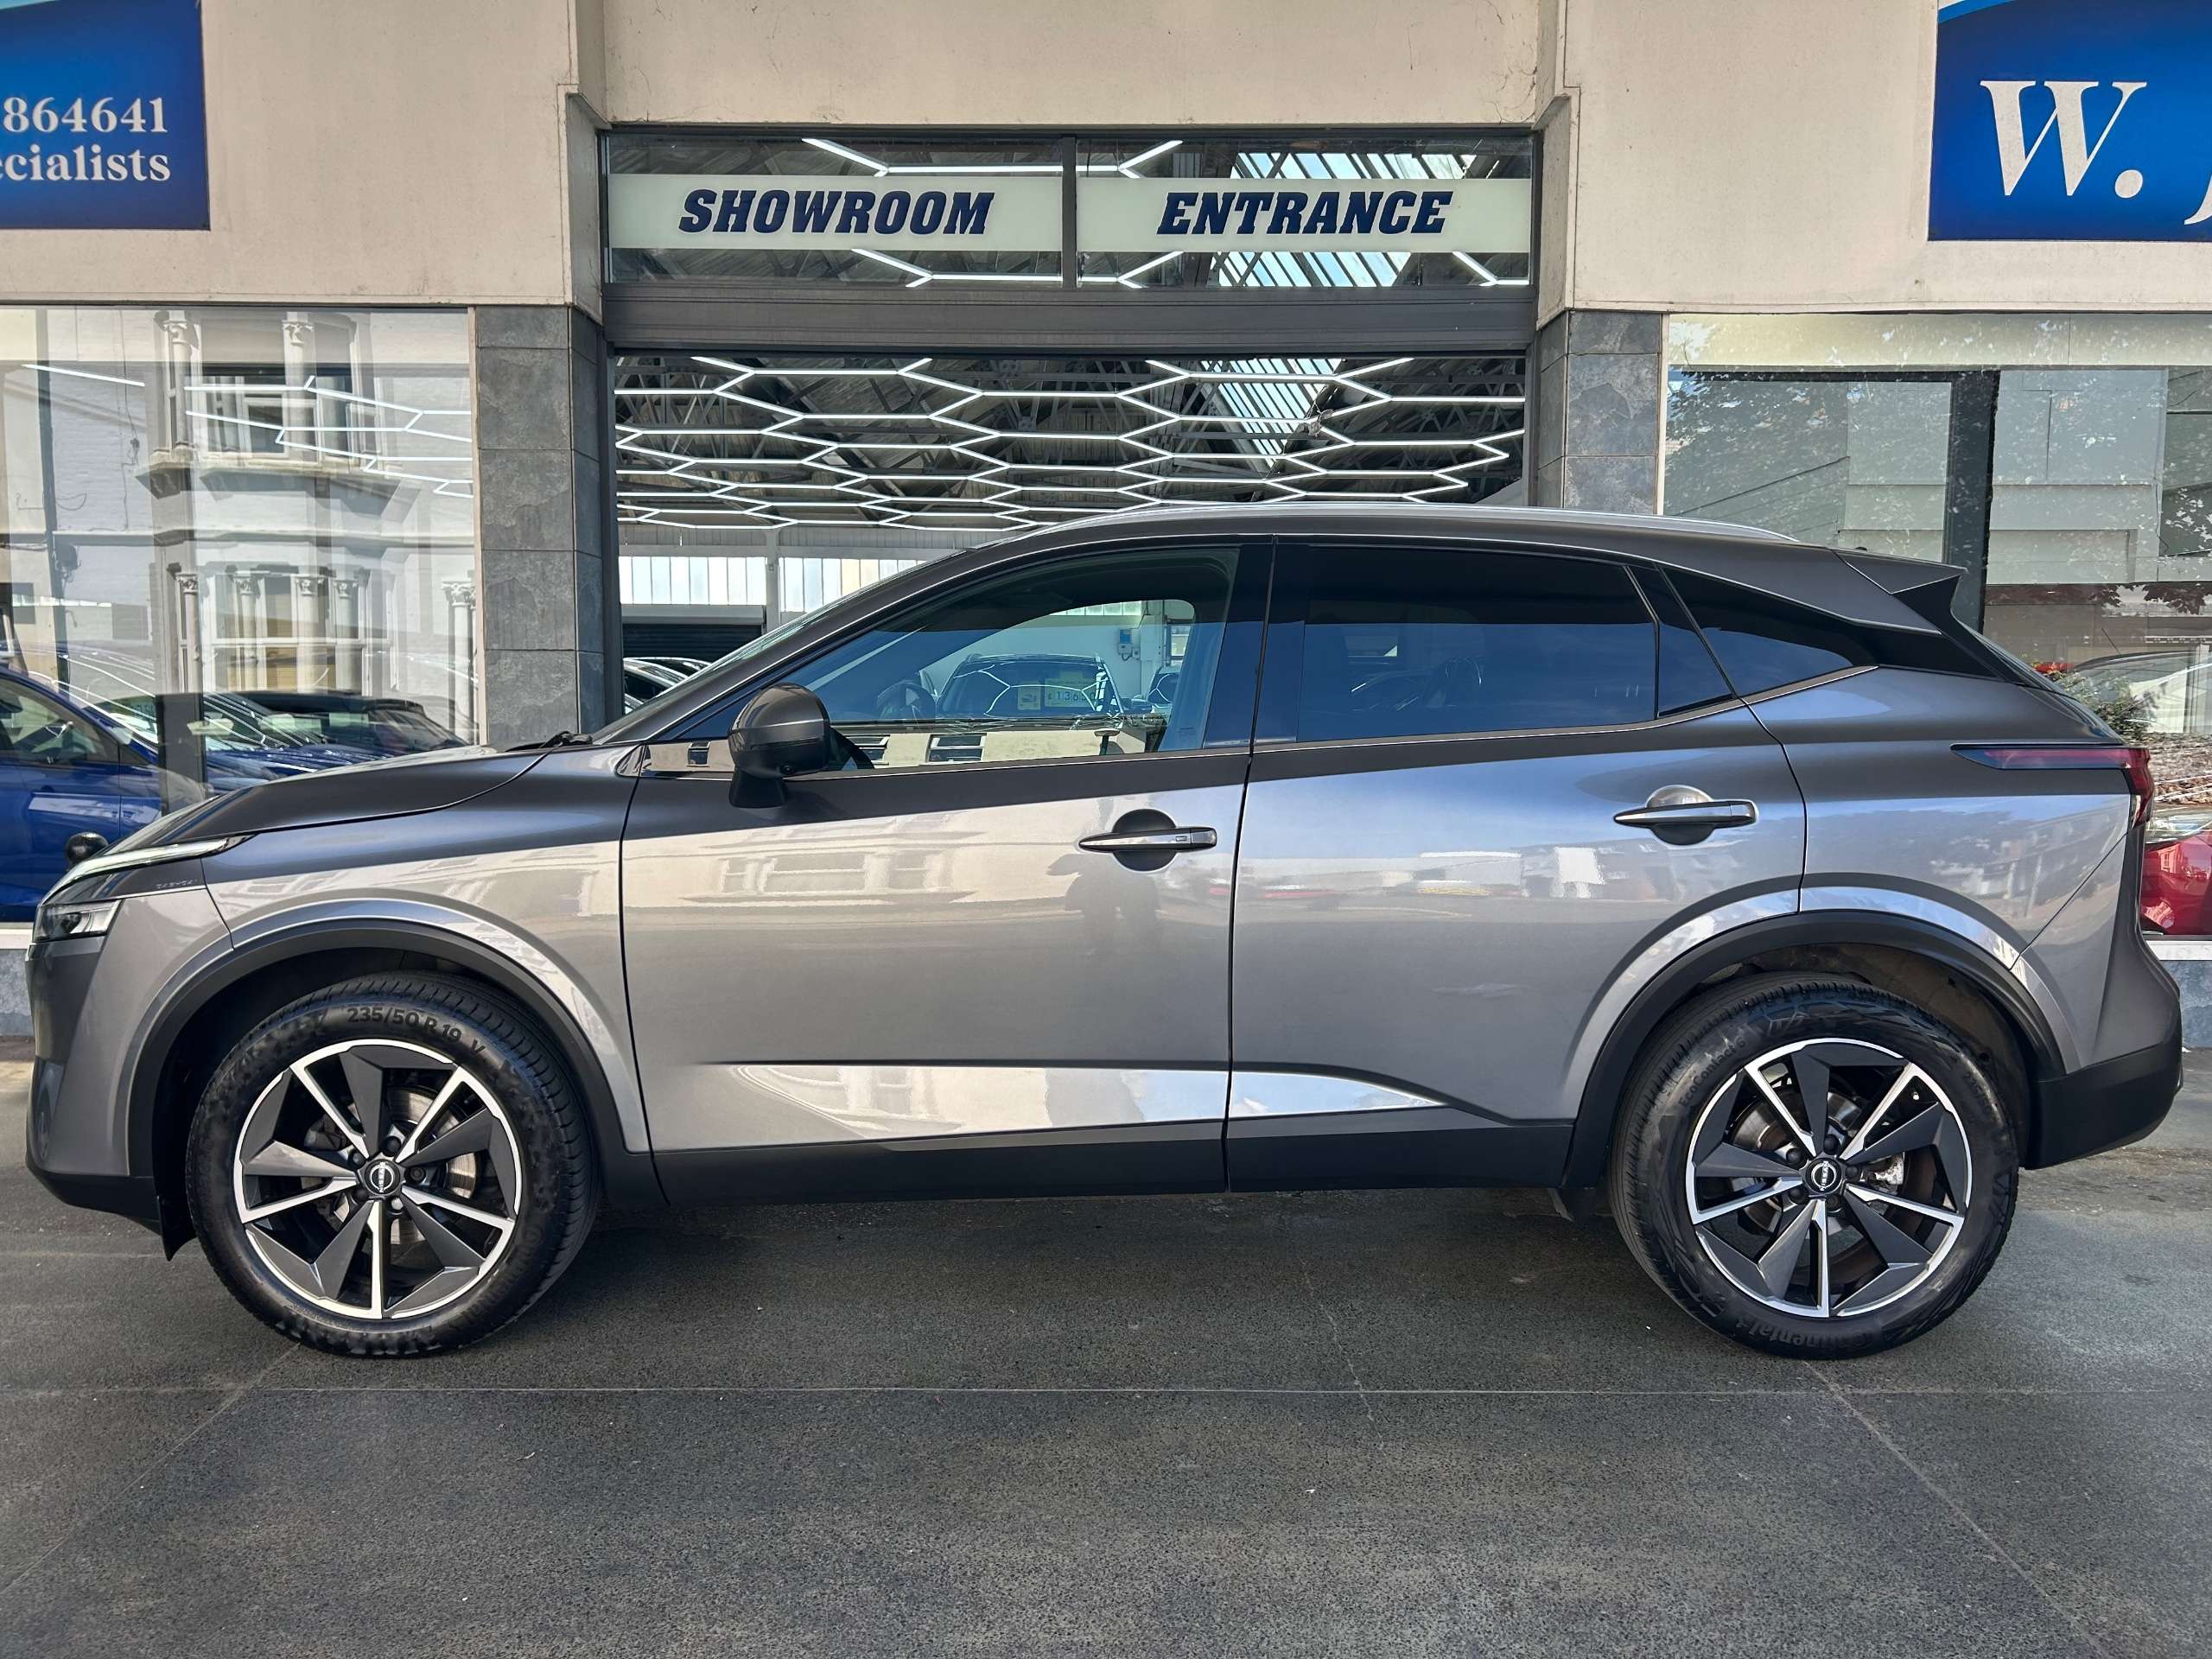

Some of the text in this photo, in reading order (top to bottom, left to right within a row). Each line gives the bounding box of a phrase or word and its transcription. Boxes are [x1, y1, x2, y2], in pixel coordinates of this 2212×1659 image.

[3, 97, 168, 133] 864641
[0, 143, 171, 181] cialists
[1980, 80, 2147, 199] W.
[678, 188, 995, 235] SHOWROOM
[1156, 190, 1453, 235] ENTRANCE
[346, 1007, 486, 1056] 235/50 R 19 V
